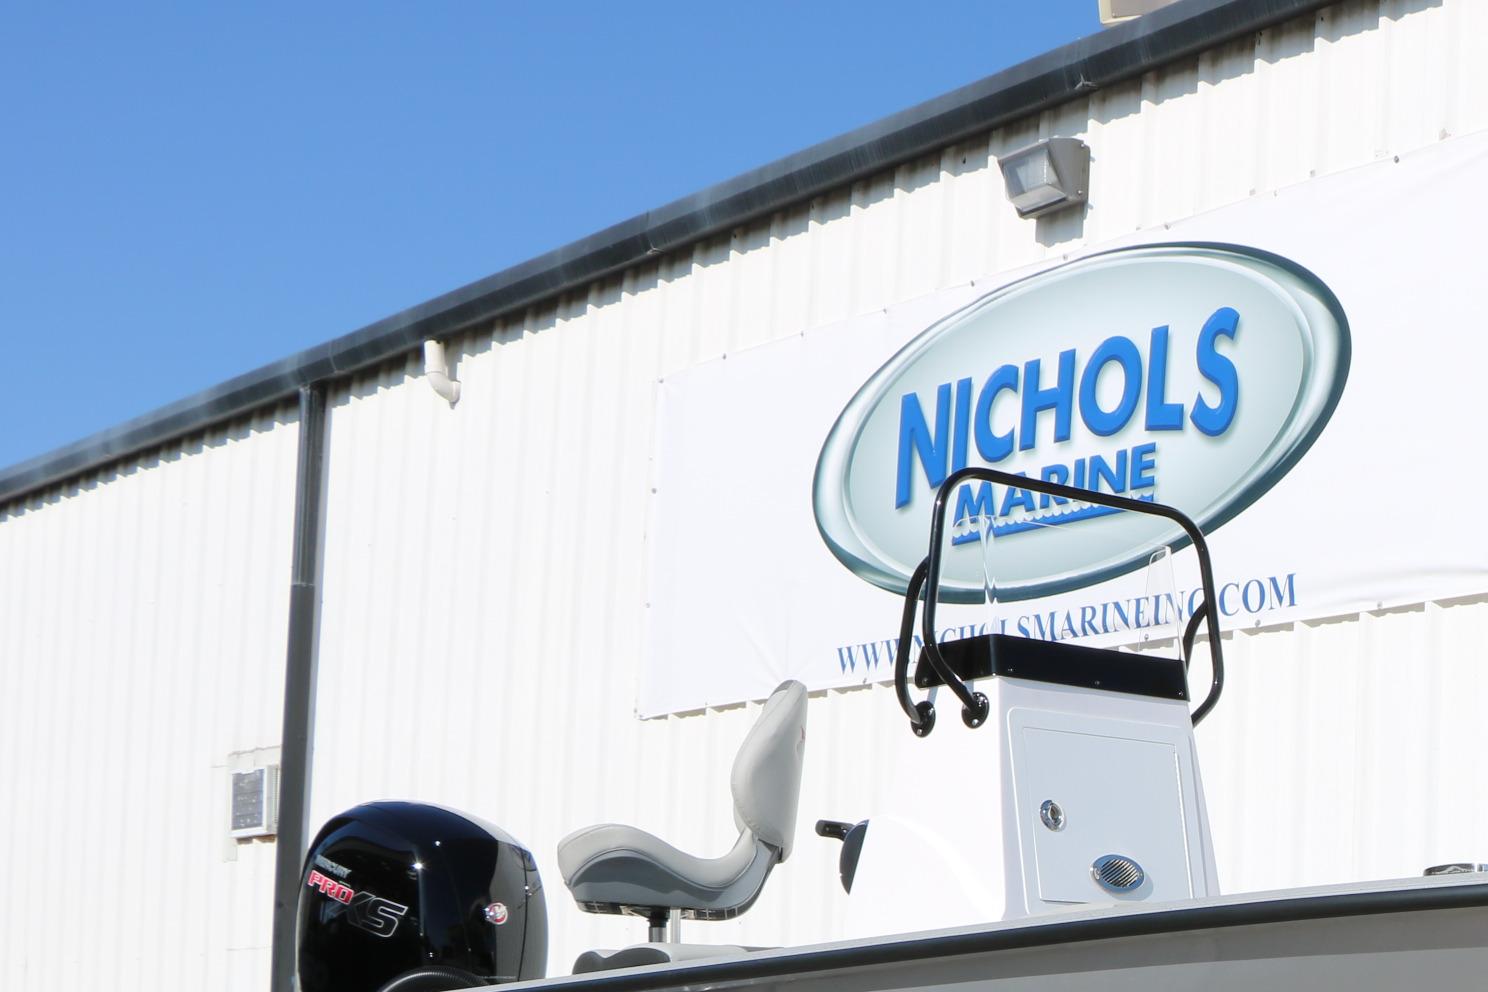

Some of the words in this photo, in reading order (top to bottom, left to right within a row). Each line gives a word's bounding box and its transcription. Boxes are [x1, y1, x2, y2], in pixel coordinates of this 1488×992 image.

[895, 306, 1240, 509] NICHOLS
[953, 442, 1156, 526] MARINE
[836, 573, 1297, 675] WWWNCHSMARINEINCCOM
[308, 869, 354, 905] PRO
